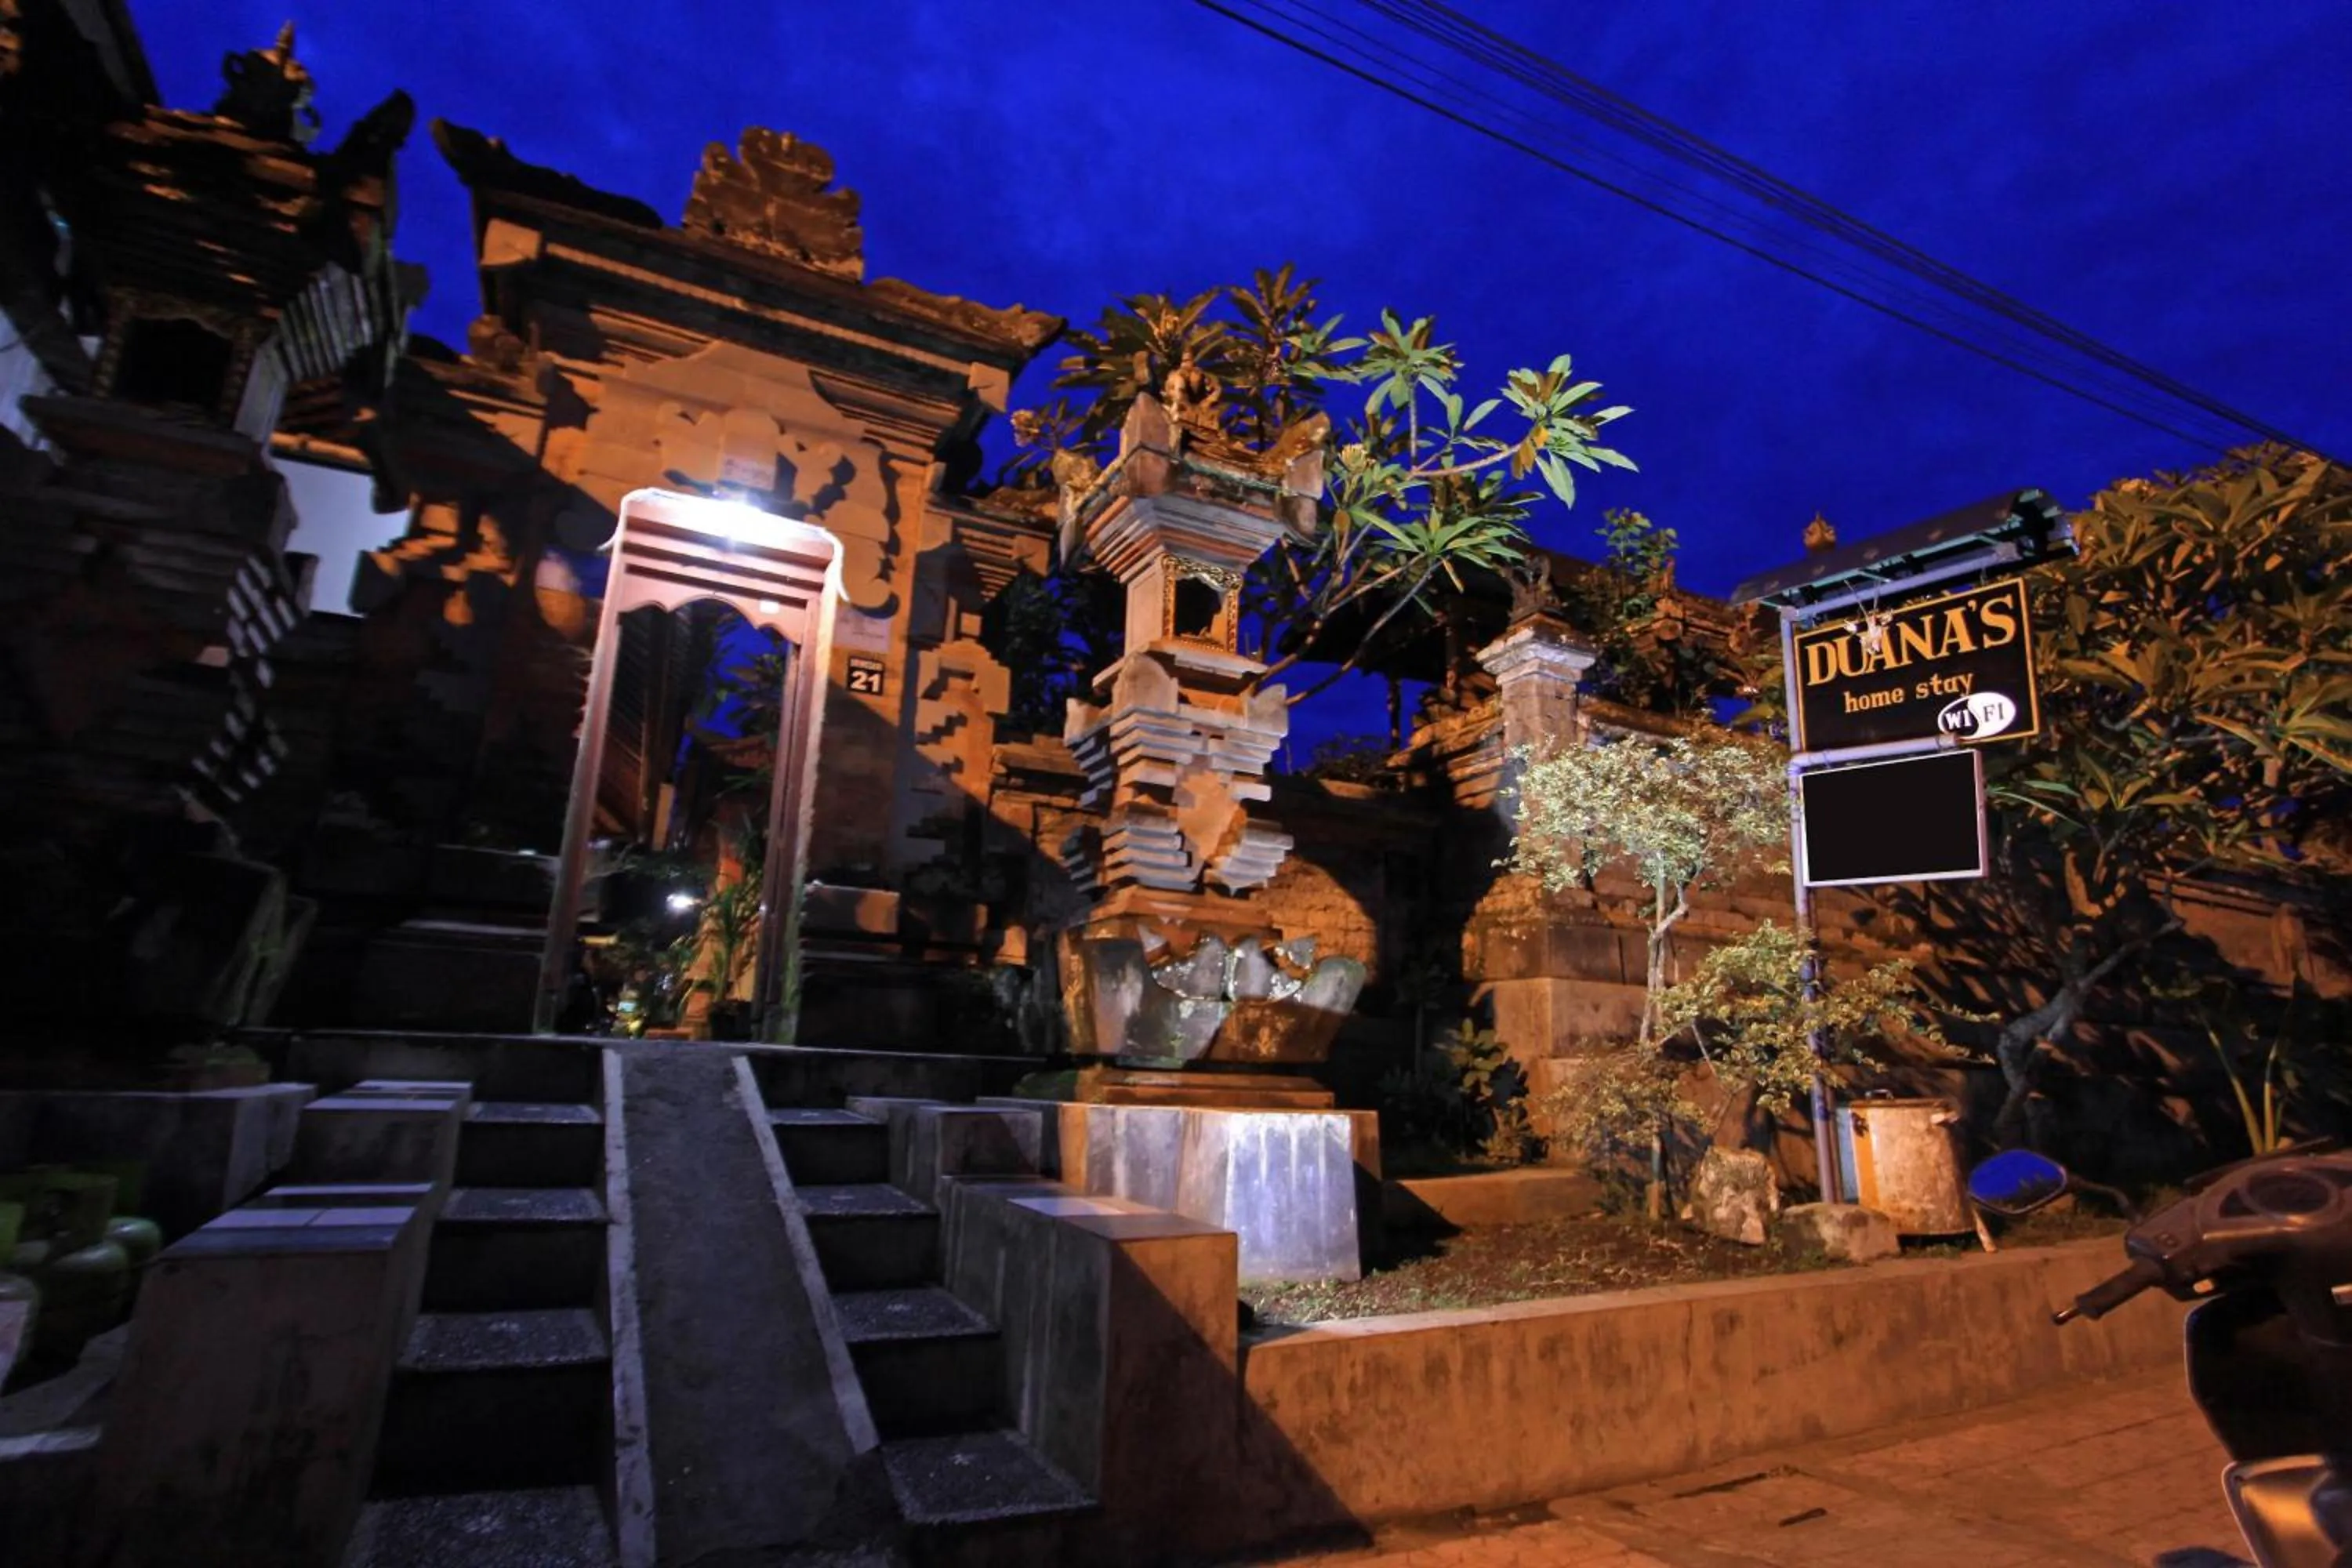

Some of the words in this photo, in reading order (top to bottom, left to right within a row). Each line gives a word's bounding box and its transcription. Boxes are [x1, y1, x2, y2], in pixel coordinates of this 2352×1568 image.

[1805, 593, 2016, 686] DUANA'S
[851, 670, 880, 692] 21
[1843, 687, 1904, 713] home
[1915, 673, 1973, 699] stay
